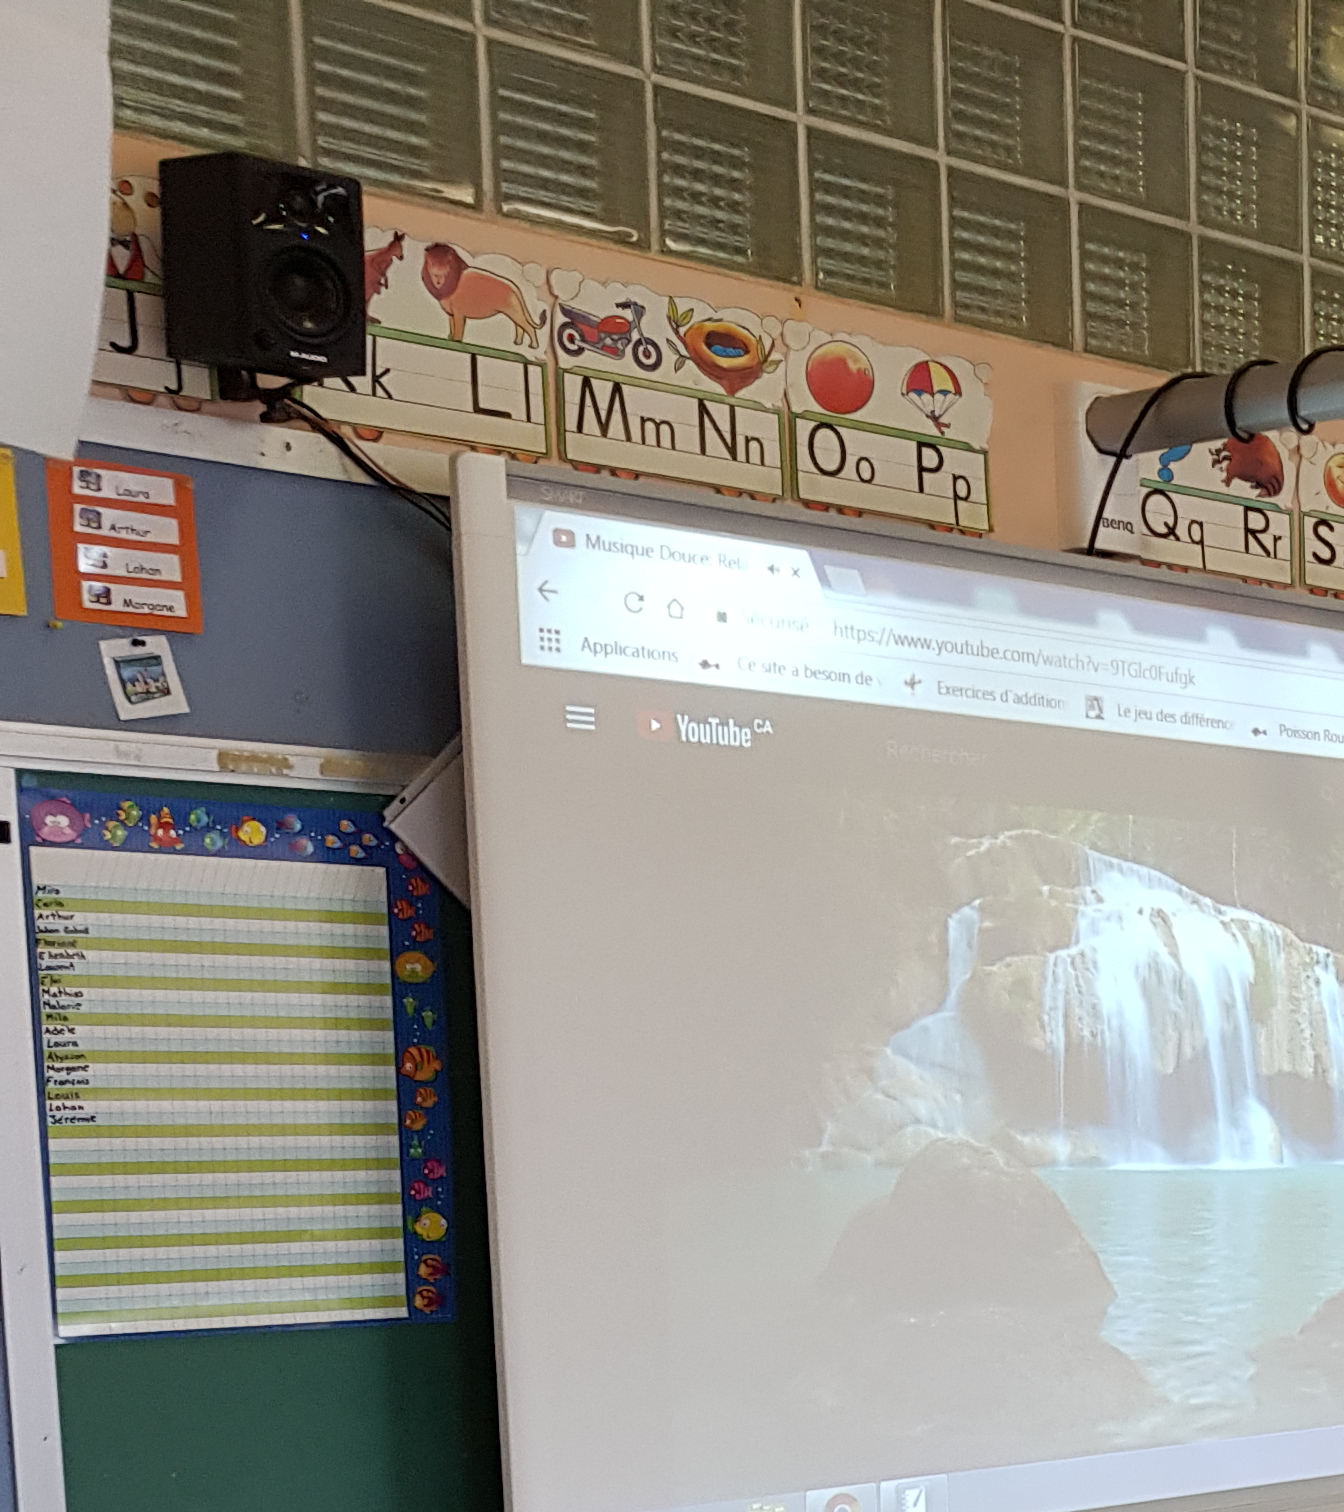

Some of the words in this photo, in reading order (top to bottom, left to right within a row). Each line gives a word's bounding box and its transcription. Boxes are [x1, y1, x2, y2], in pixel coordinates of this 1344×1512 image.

[108, 523, 151, 538] Arthur
[585, 532, 655, 560] Musique
[581, 636, 680, 663] Applications
[737, 655, 757, 672] Ce
[761, 660, 787, 677] site
[790, 665, 800, 678] a
[803, 664, 851, 684] besoin
[854, 670, 873, 687] de
[937, 680, 997, 703] Exercices
[1117, 703, 1130, 719] Le
[1132, 706, 1153, 725] jeu
[1156, 709, 1178, 725] des
[676, 713, 752, 748] YouTube
[753, 718, 774, 735] CA
[1278, 723, 1321, 743] Poisson
